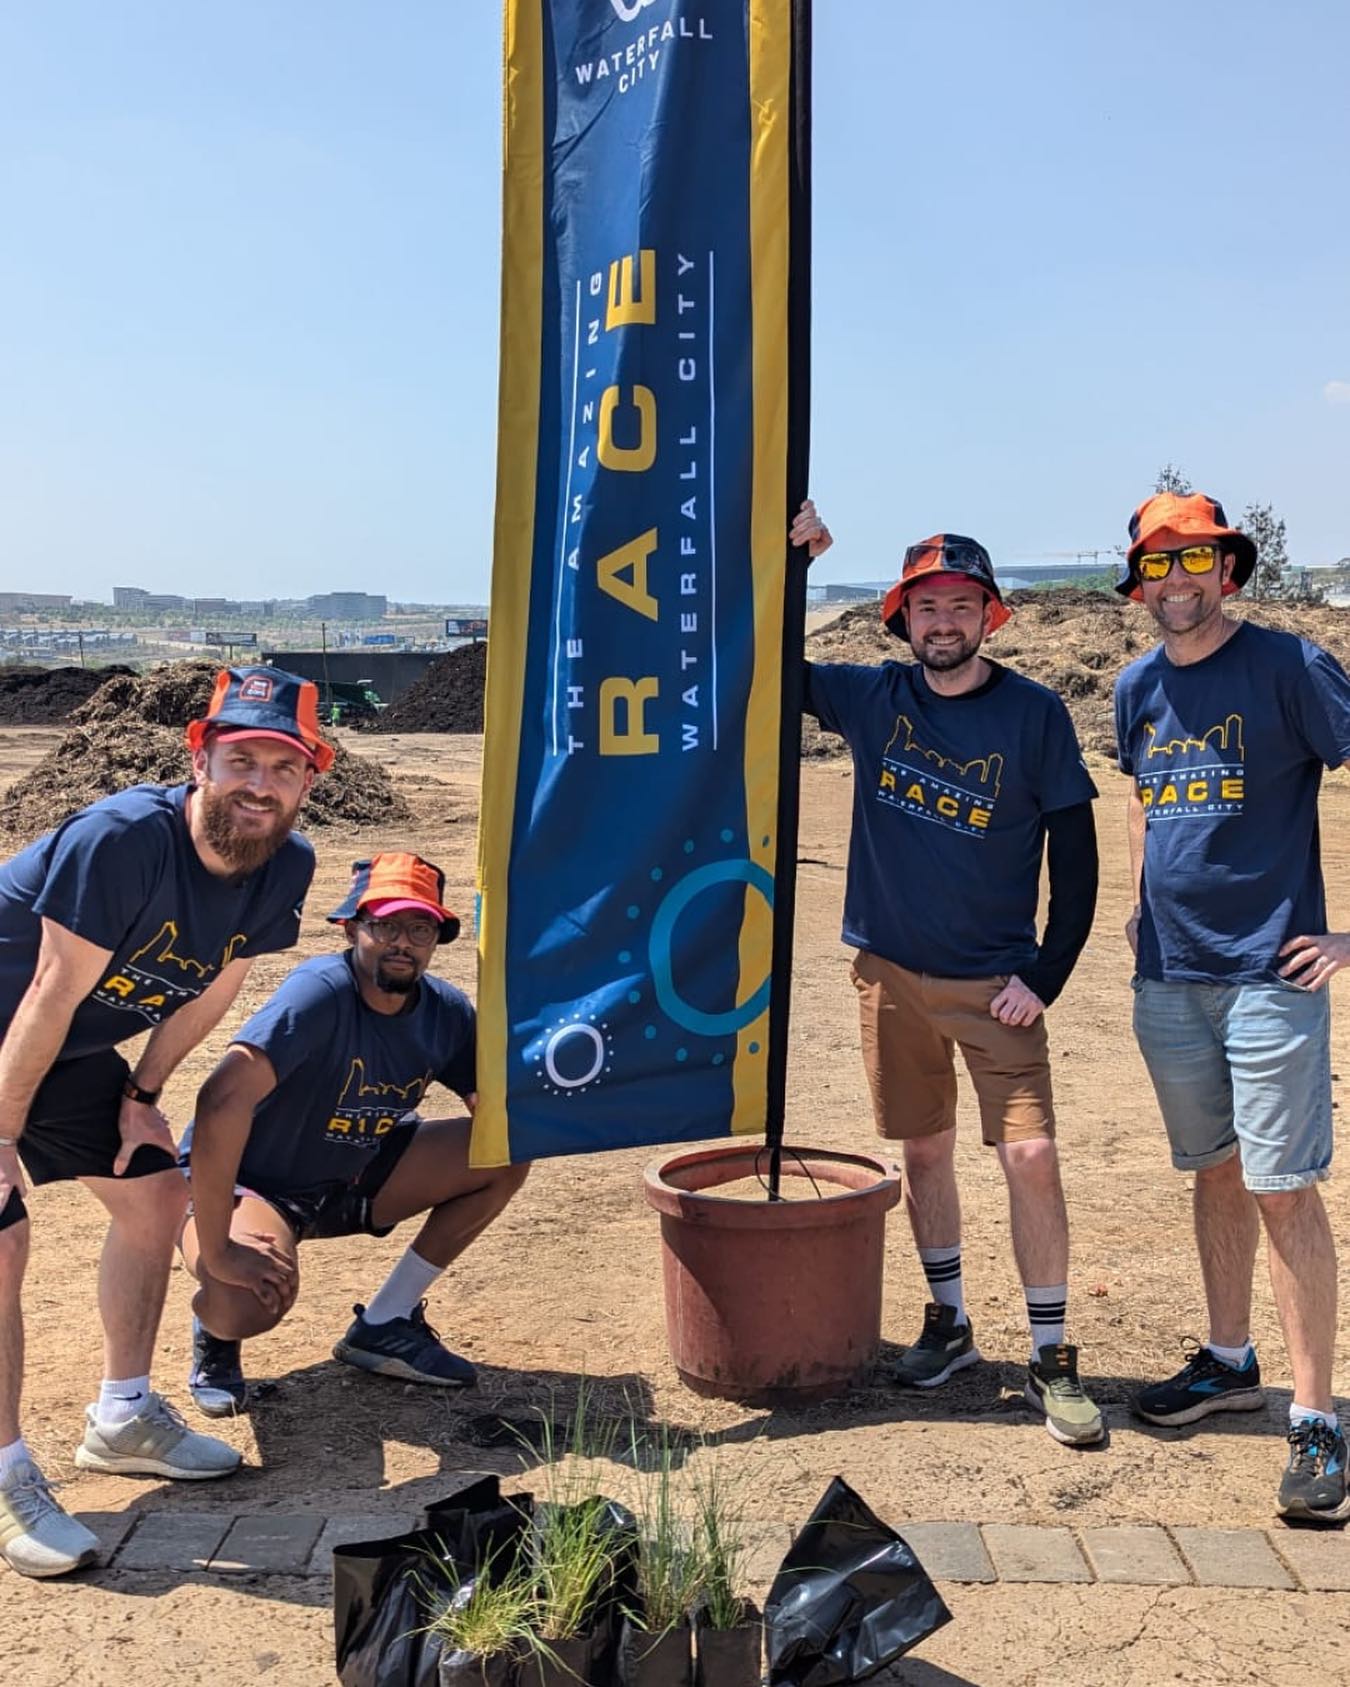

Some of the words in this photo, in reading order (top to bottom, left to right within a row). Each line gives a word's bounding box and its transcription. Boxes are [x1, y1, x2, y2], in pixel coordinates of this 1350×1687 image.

[575, 16, 713, 84] WATERFALL
[618, 49, 660, 94] CITY
[677, 253, 696, 381] CITY
[567, 271, 602, 571] AMAZING
[597, 248, 660, 756] RACE
[680, 426, 699, 751] WATERFALL
[567, 638, 584, 755] THE
[880, 770, 991, 828] RACE
[919, 777, 994, 810] AMAZING
[1170, 769, 1244, 781] AMAZING
